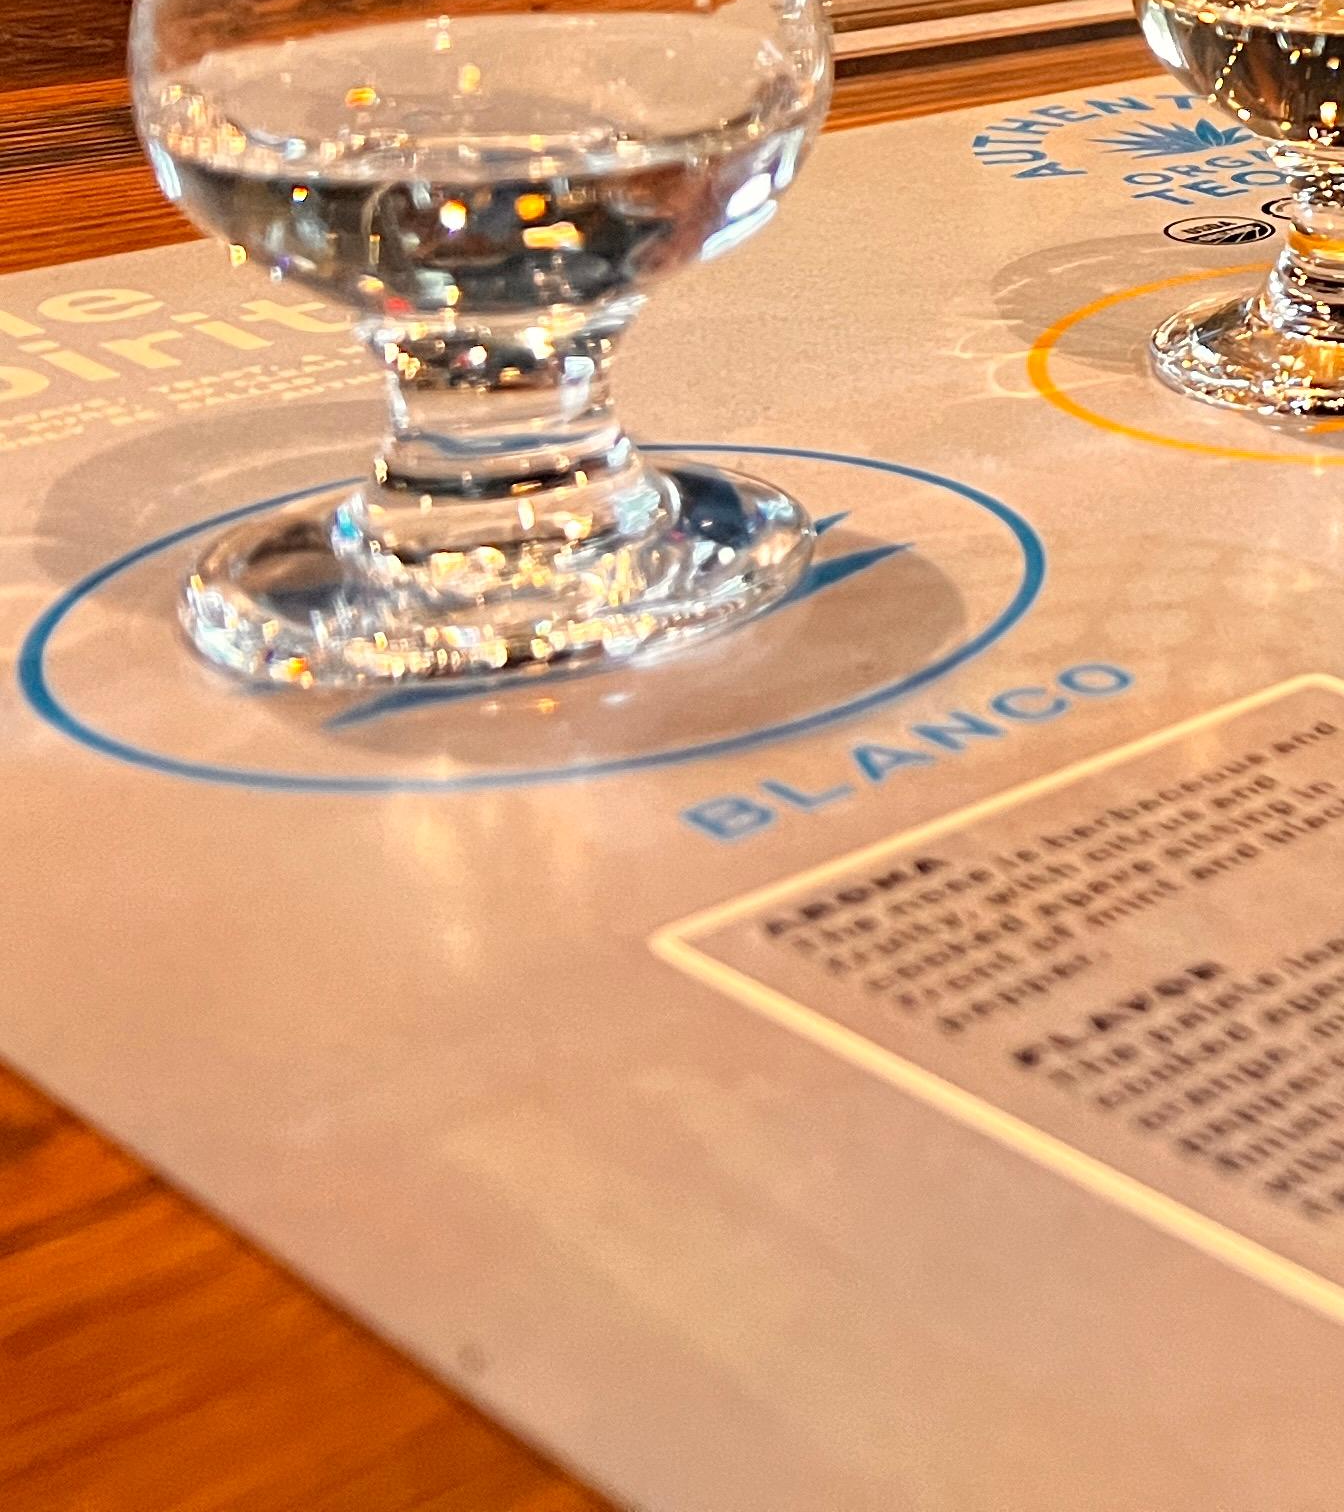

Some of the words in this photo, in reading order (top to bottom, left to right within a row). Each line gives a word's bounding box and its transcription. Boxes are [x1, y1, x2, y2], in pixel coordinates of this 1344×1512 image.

[680, 663, 1134, 842] BLANCO
[765, 857, 945, 937] AROMA
[1013, 963, 1222, 1069] FLAVOR
